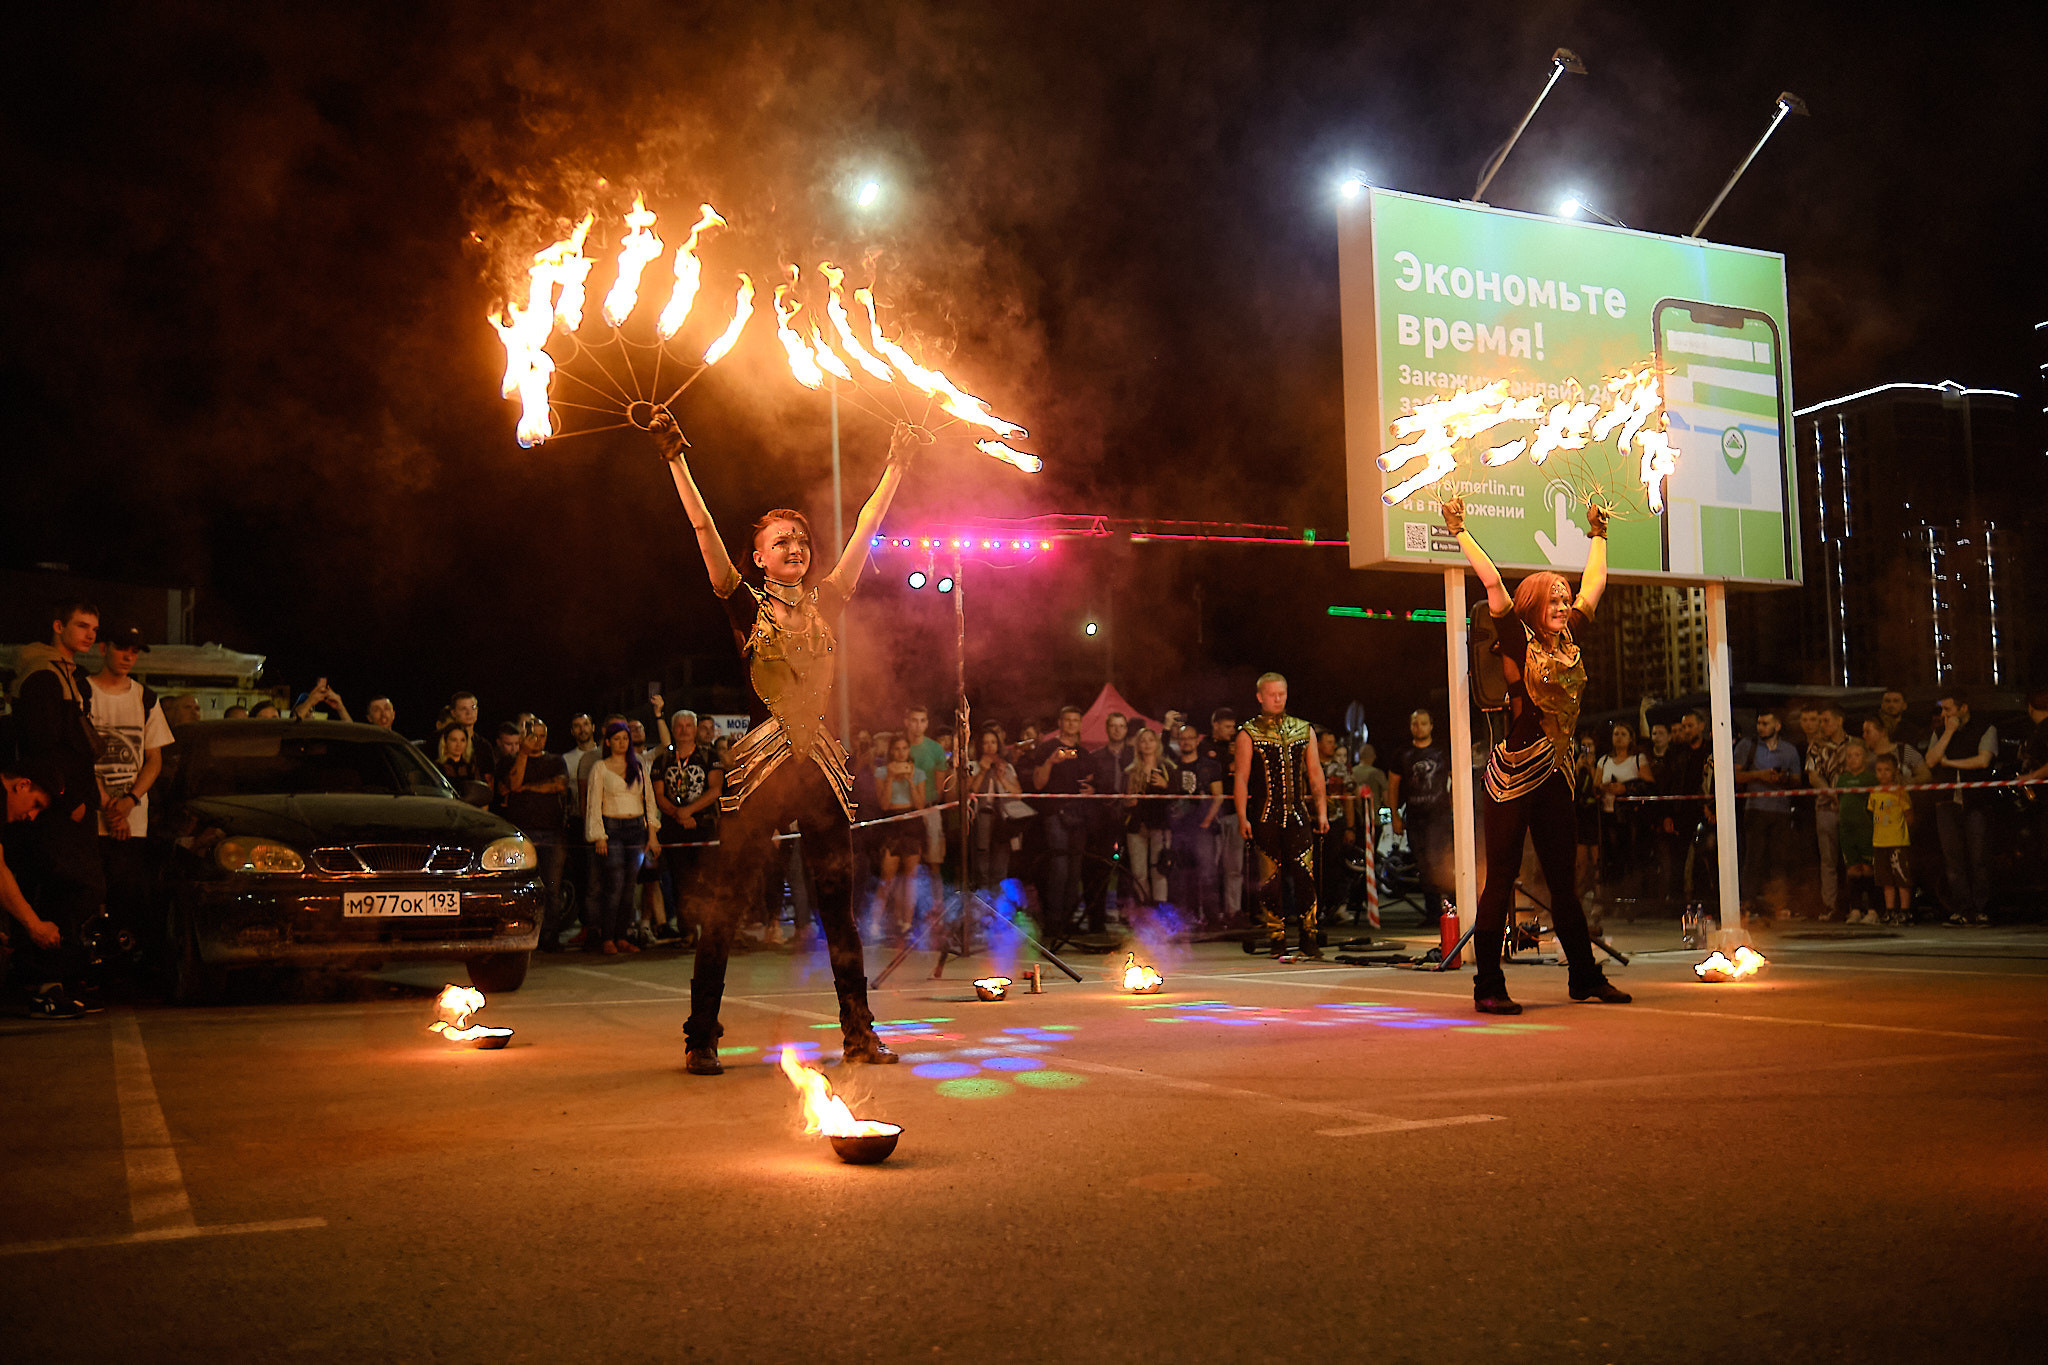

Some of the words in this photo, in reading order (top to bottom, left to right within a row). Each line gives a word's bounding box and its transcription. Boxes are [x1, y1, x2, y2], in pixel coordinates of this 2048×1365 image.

[1393, 250, 1627, 319] Экономьте
[1397, 313, 1545, 361] время!
[1398, 364, 1492, 391] Закажи
[1428, 501, 1525, 519] прожении
[726, 719, 748, 729] МОБ
[428, 893, 455, 907] 193
